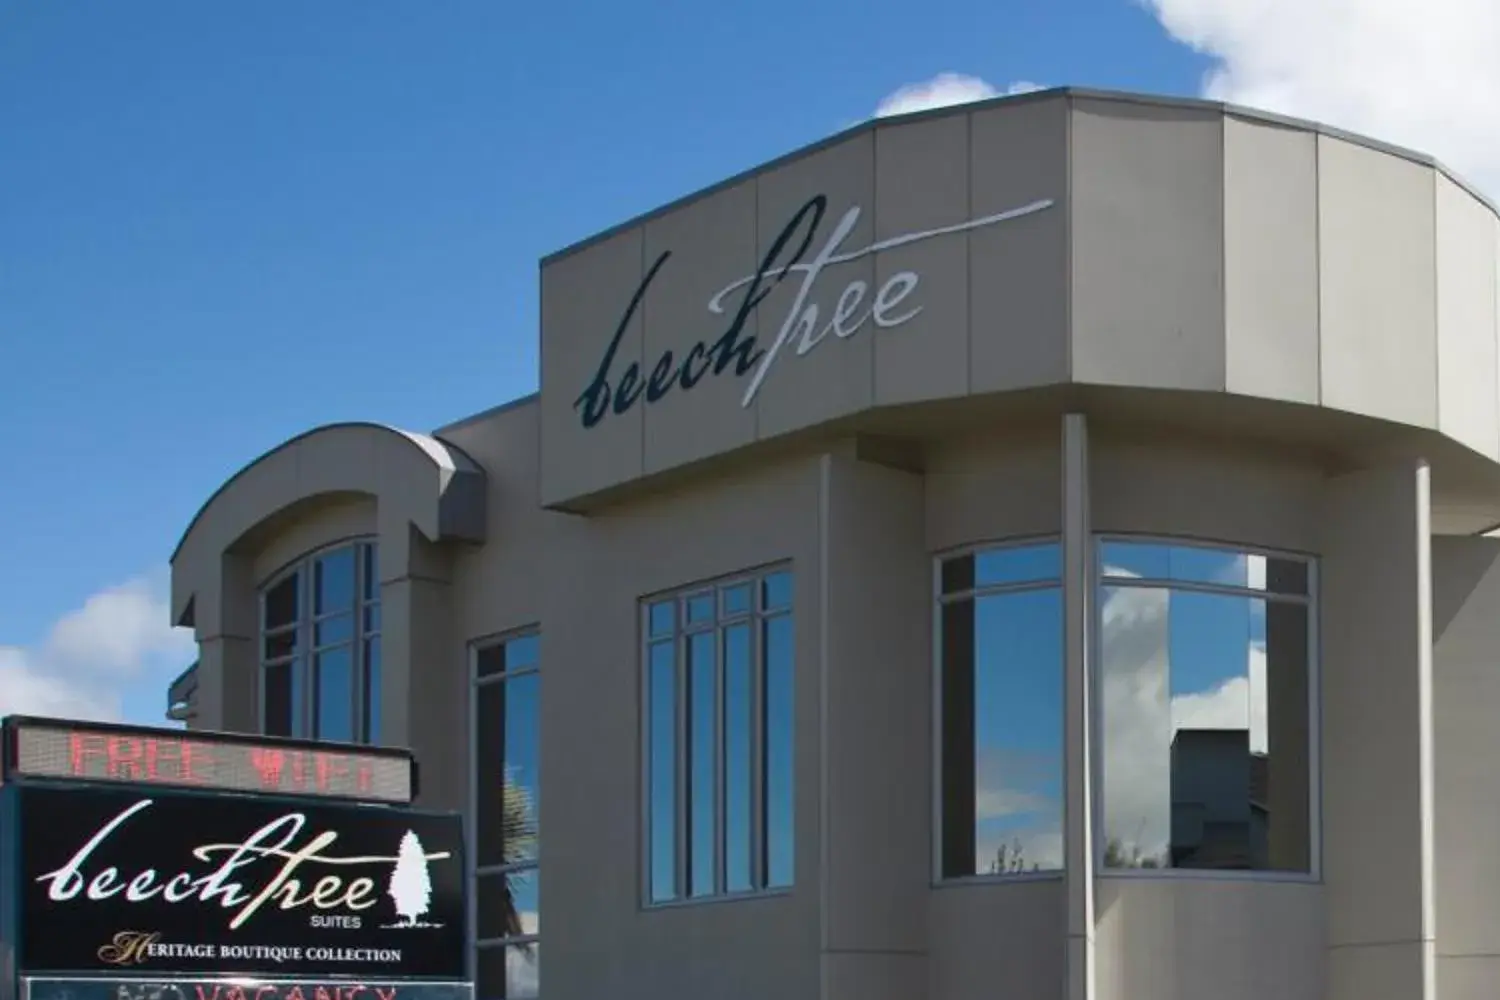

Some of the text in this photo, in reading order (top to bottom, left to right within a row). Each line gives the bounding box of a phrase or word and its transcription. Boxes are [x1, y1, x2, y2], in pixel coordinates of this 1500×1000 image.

[71, 730, 215, 787] FREE
[310, 914, 362, 930] SUITES
[220, 944, 303, 963] BOUTIQUE
[305, 945, 402, 962] COLLECTION
